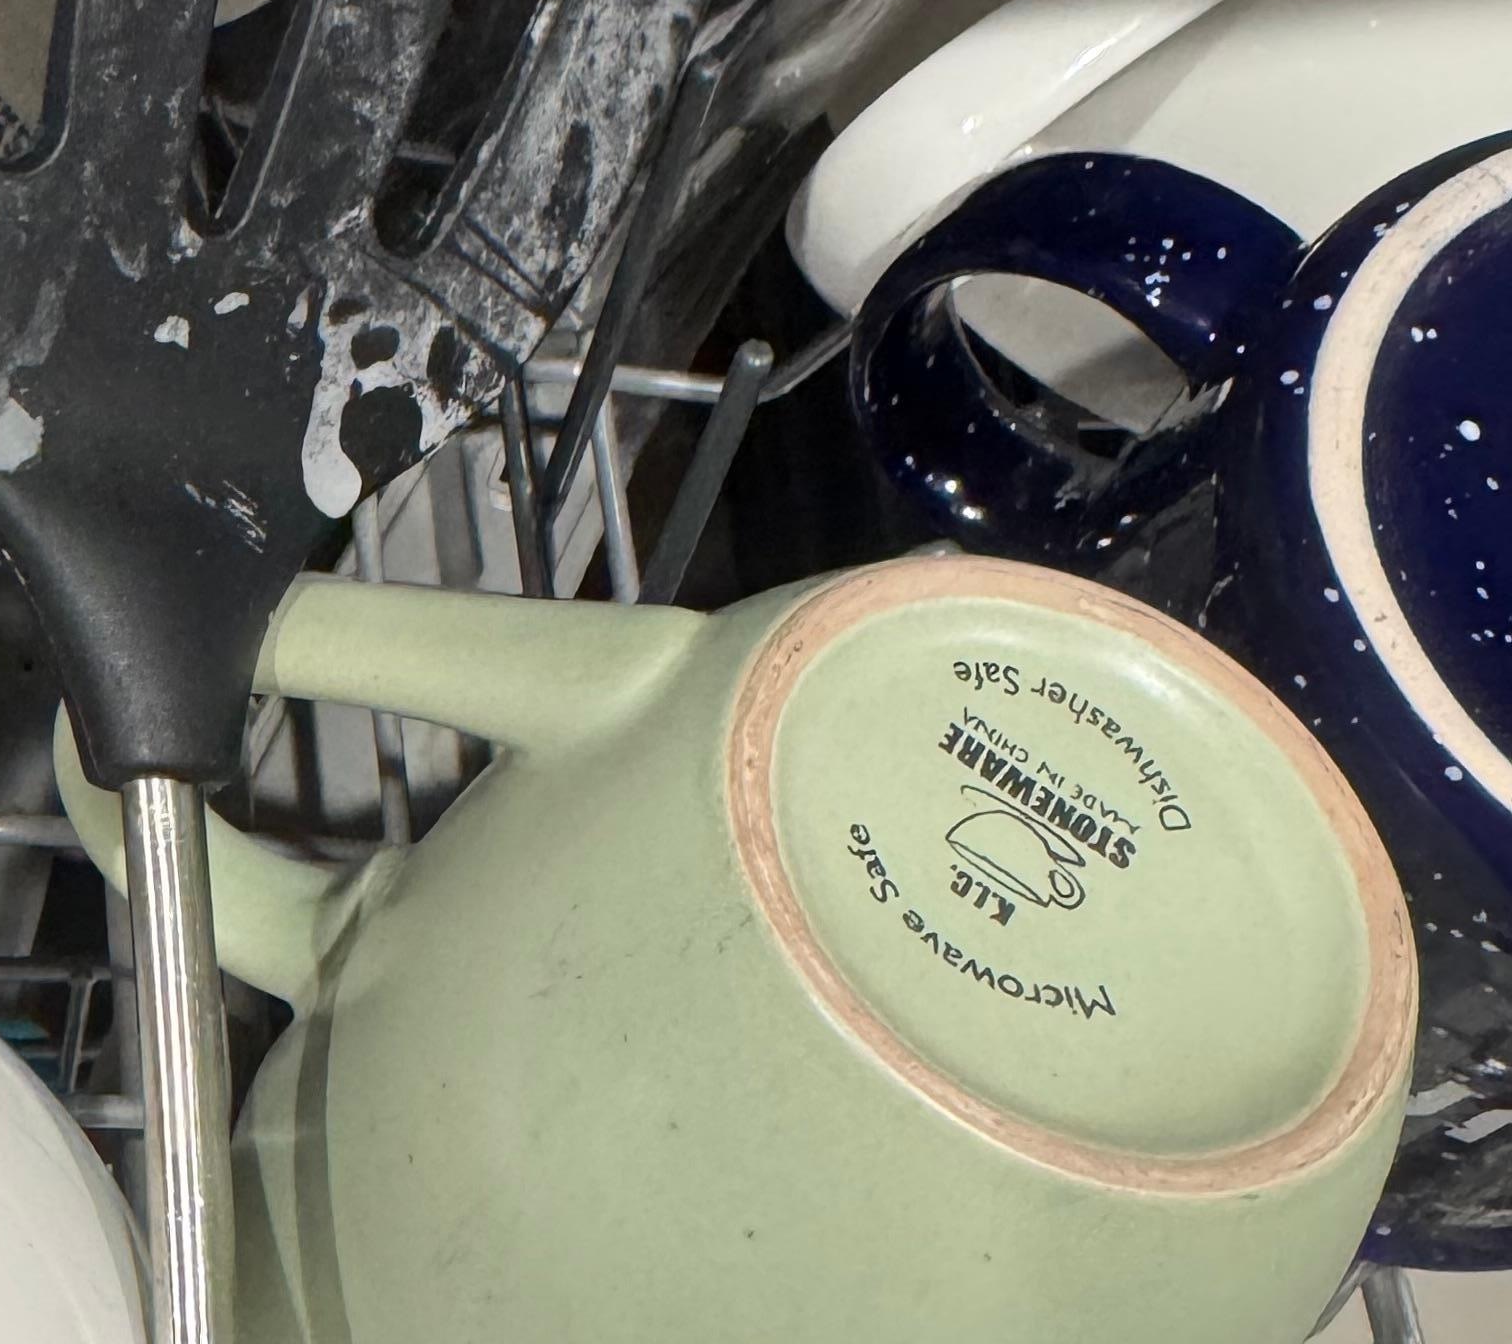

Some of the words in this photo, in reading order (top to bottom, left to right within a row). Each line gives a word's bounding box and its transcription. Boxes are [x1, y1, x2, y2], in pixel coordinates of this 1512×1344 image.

[952, 660, 1020, 696] Safe
[962, 706, 1029, 763] CHINA
[1030, 676, 1192, 831] Dishwasher
[937, 721, 1137, 870] STONEWARE
[1036, 760, 1066, 789] IN
[1070, 783, 1140, 835] MADE
[847, 823, 900, 904] Safe
[901, 909, 1117, 1020] Microwave
